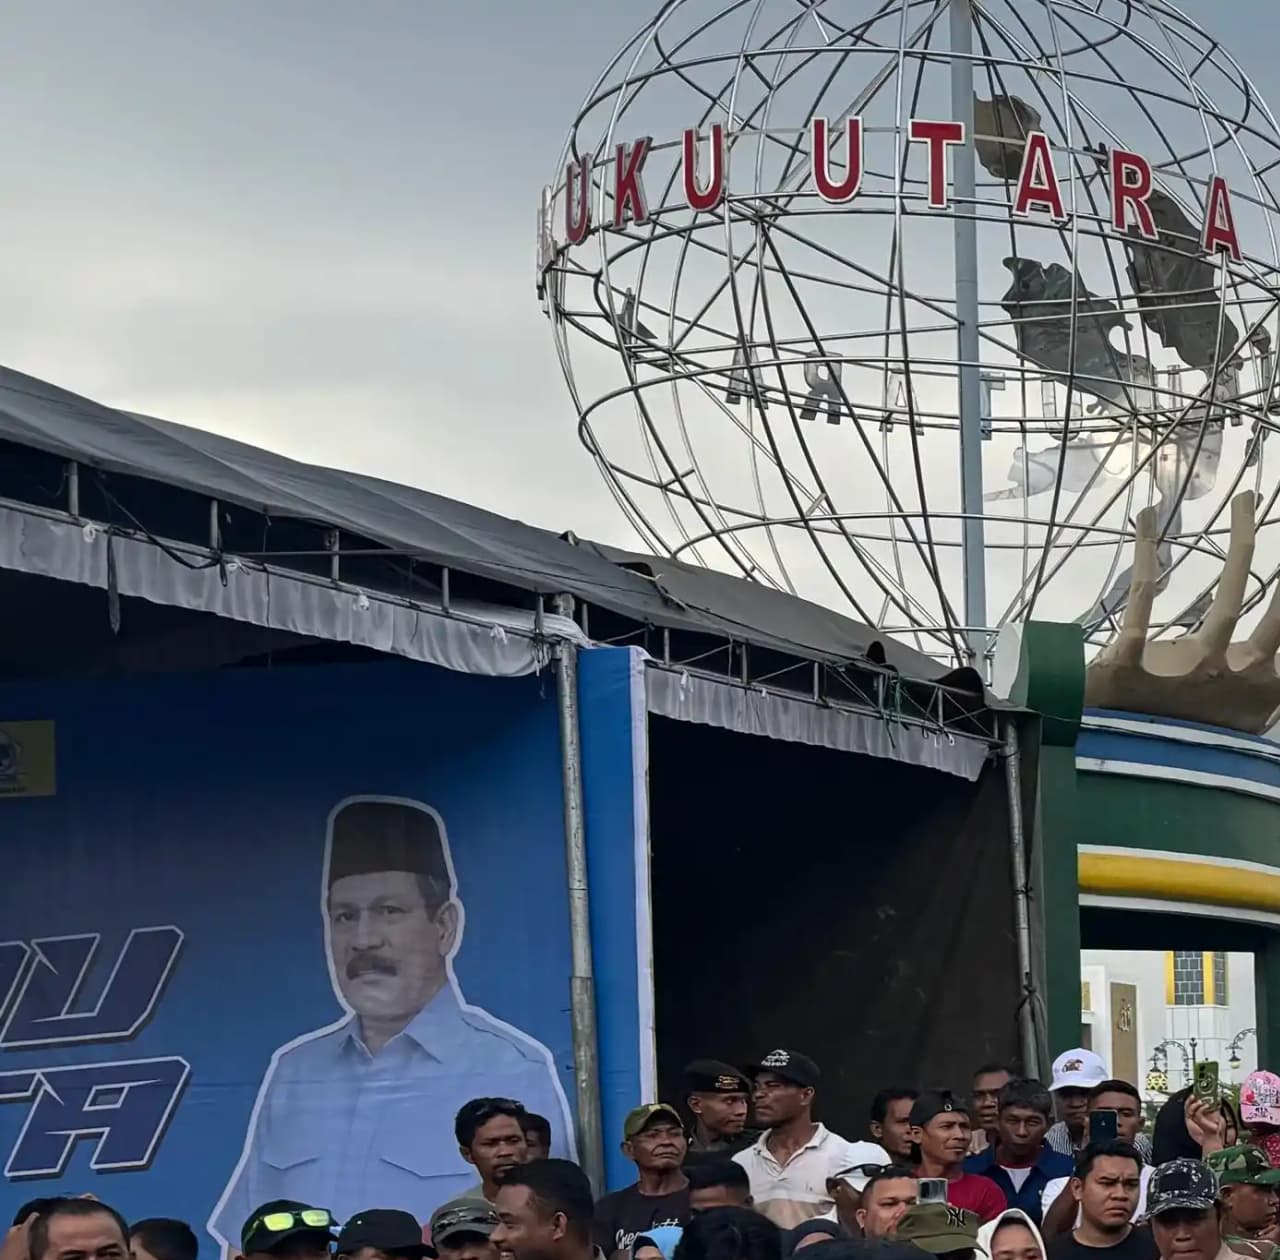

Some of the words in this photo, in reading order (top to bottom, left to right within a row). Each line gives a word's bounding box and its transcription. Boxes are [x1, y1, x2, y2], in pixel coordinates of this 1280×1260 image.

[562, 121, 726, 246] UKU
[810, 115, 1245, 264] UTARA
[0, 924, 185, 1048] U
